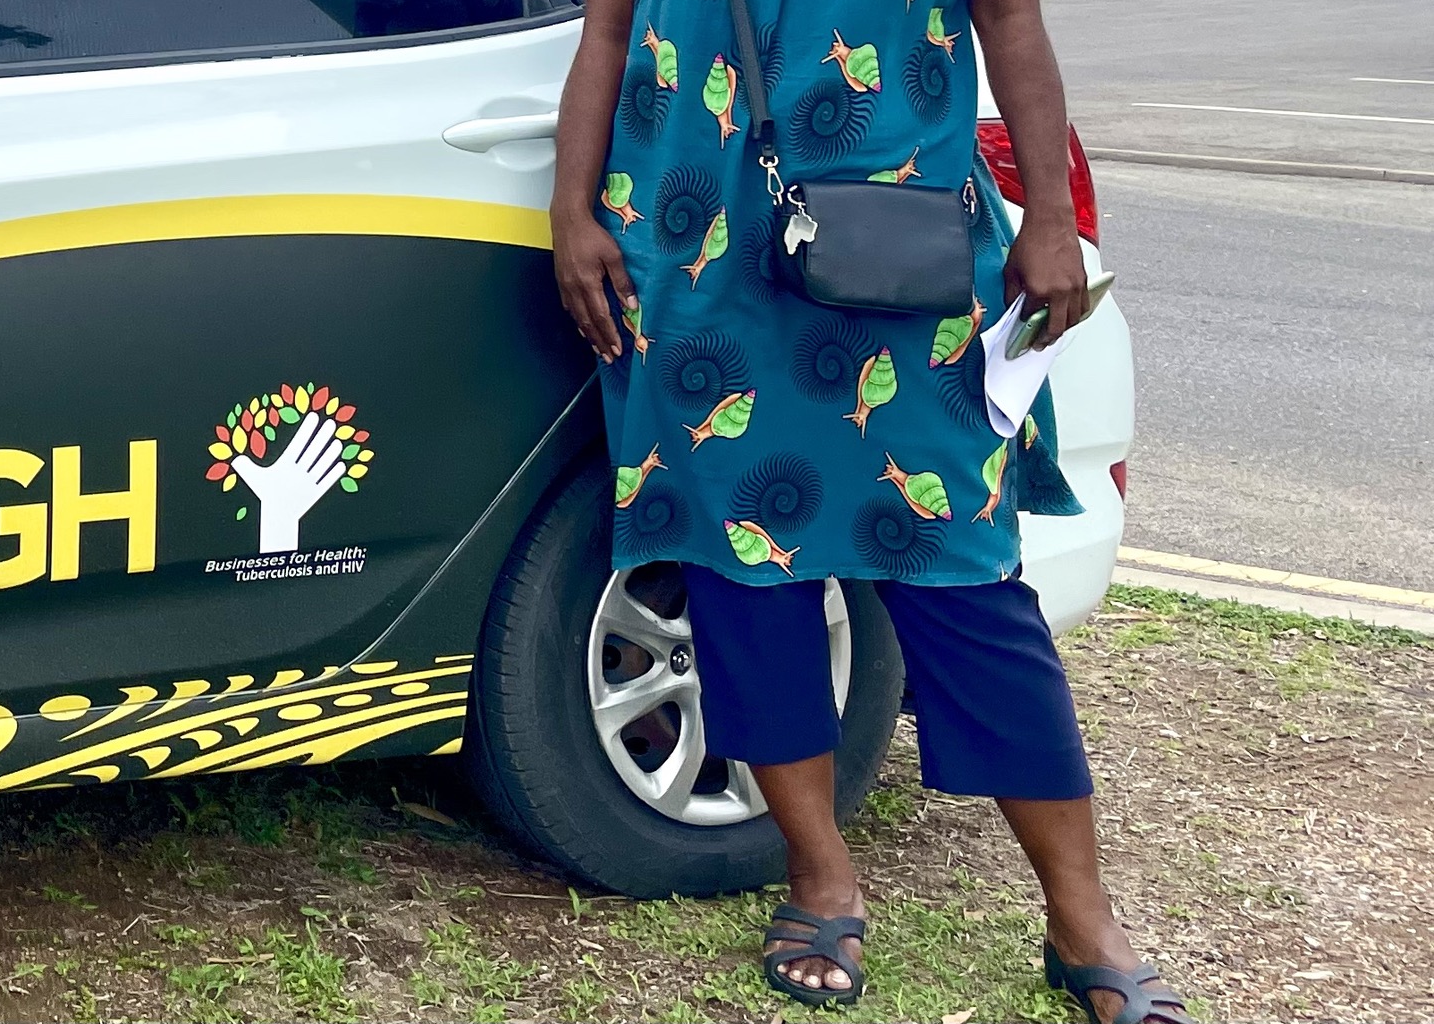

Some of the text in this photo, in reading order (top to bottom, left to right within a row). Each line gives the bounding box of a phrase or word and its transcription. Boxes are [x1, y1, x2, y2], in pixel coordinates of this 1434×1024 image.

[205, 546, 367, 573] Businesses for Health:
[235, 560, 365, 582] Tuberculosis and HIV
